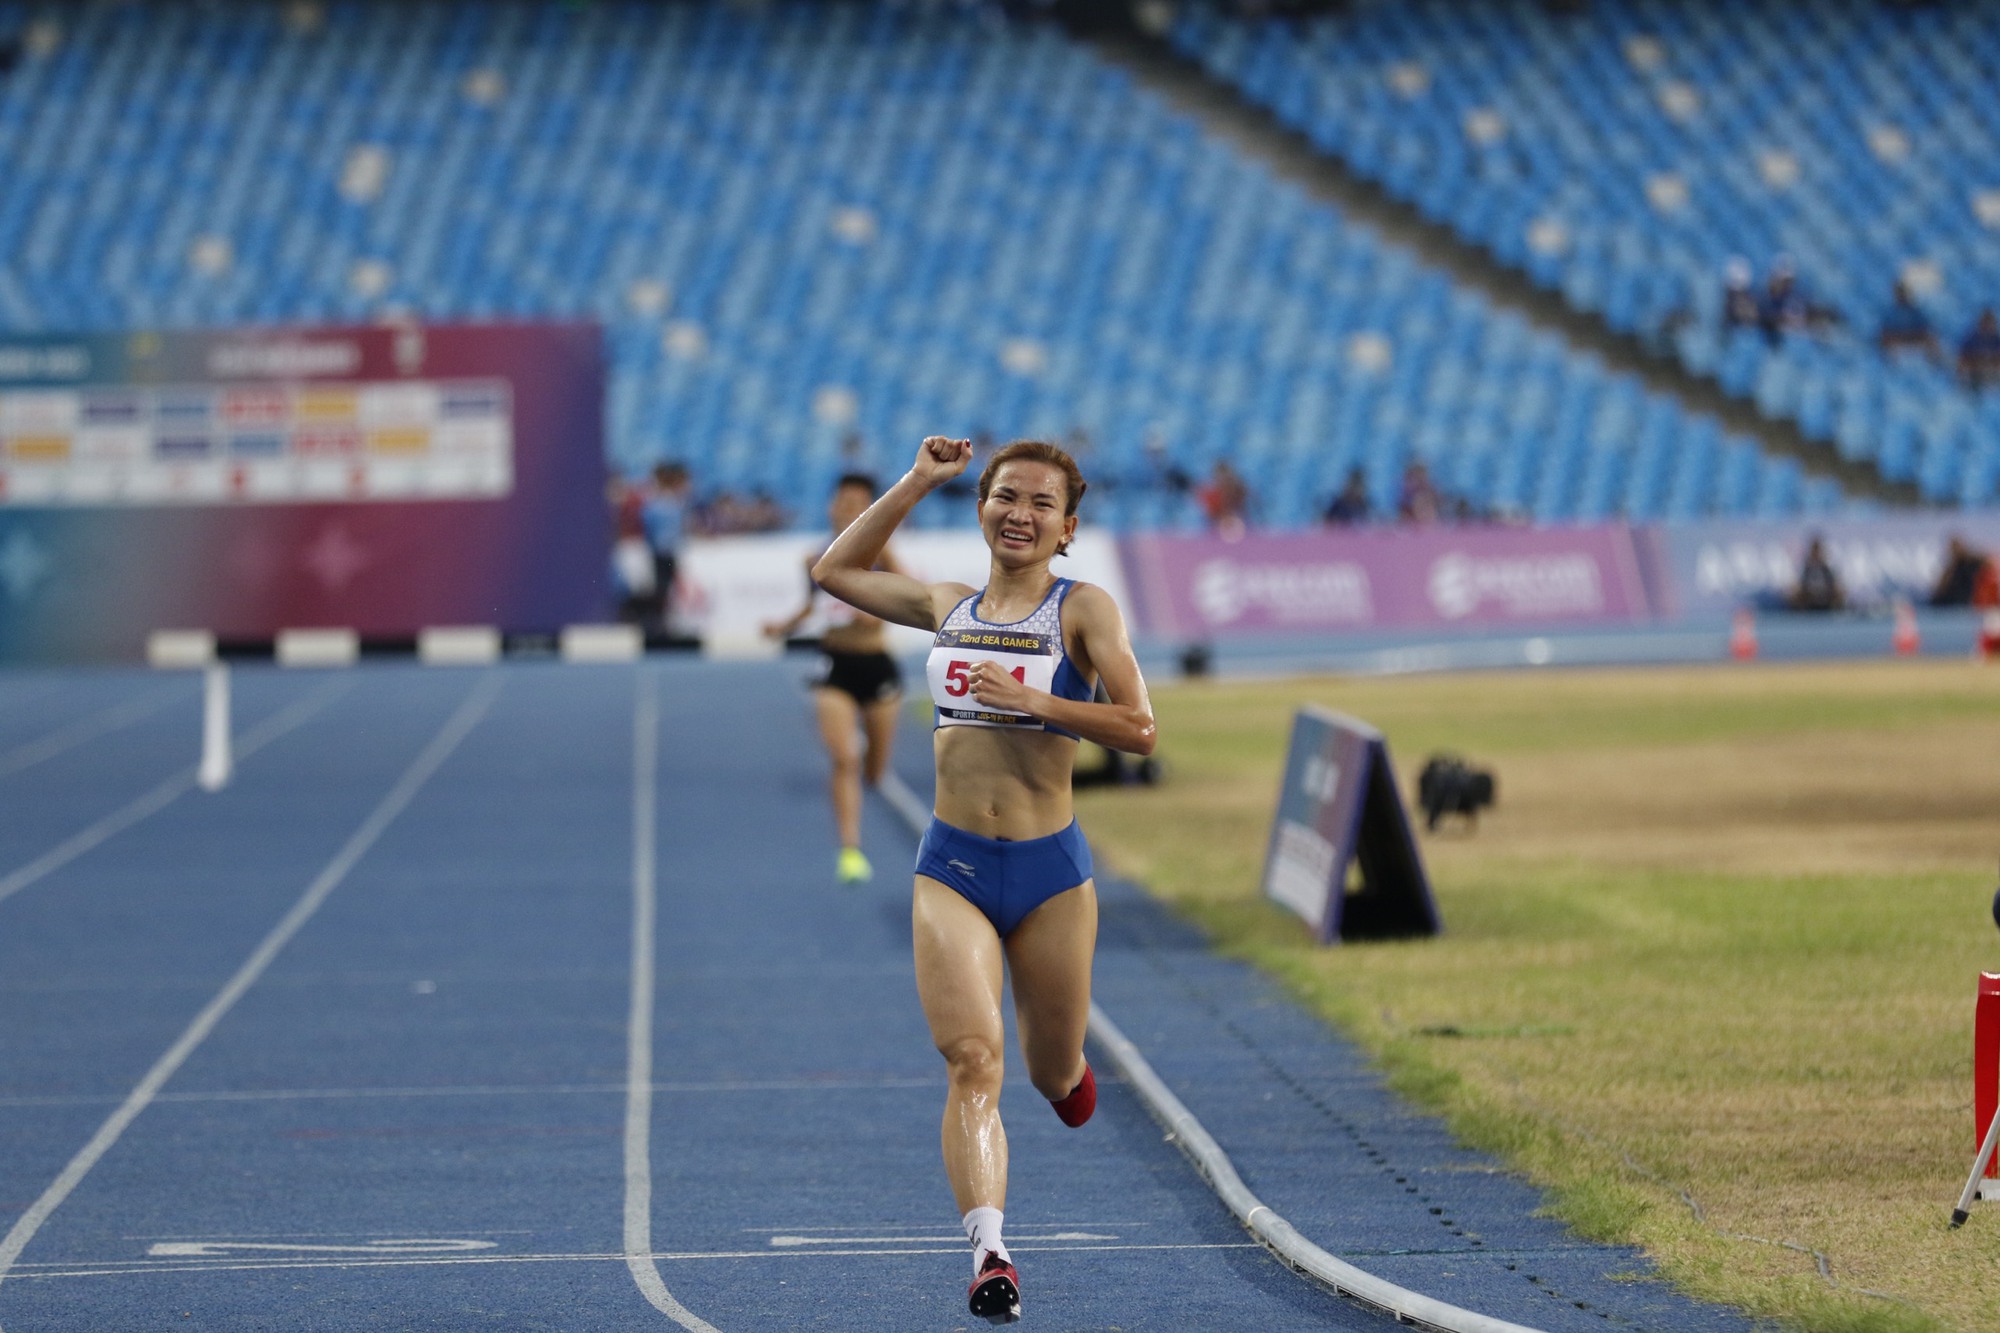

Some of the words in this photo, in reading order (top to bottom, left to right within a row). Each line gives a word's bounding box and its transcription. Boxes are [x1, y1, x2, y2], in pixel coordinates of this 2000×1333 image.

[960, 634, 980, 644] 32nd
[982, 635, 1000, 646] SEA
[1002, 637, 1040, 649] GAMES
